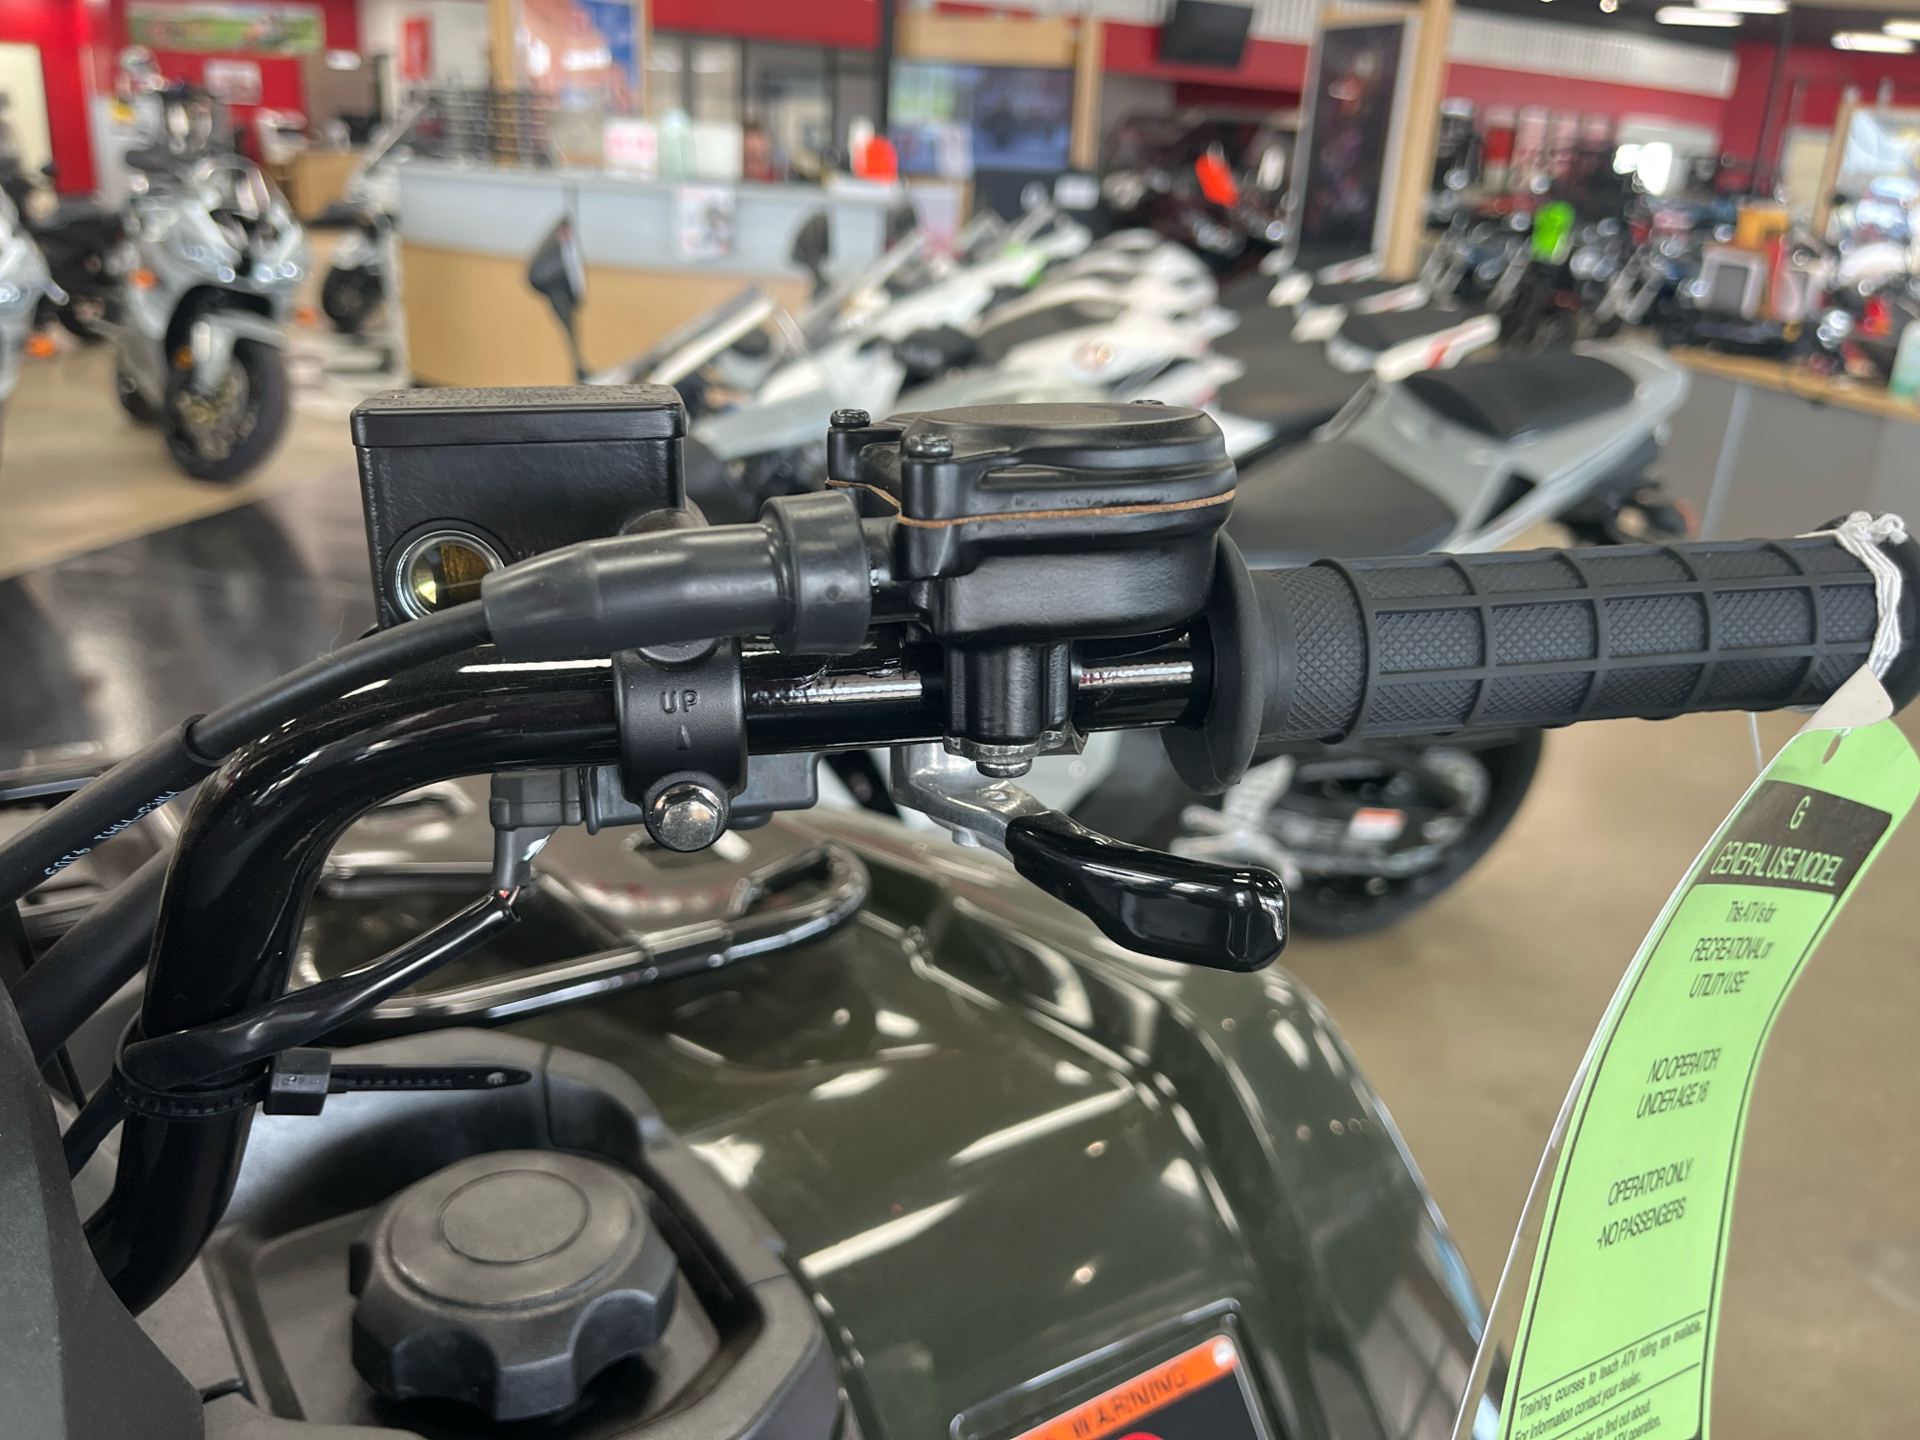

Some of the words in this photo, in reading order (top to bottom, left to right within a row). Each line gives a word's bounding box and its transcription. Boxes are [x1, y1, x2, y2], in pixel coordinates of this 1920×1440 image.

[660, 689, 699, 714] UP
[1789, 795, 1811, 830] G
[1710, 840, 1769, 876] GENERAL
[1766, 845, 1800, 880] USE
[1793, 849, 1843, 886] MODEL
[1725, 900, 1744, 923] This
[1740, 901, 1761, 923] ATV
[1689, 936, 1765, 962] RECREATIONAL
[1689, 972, 1731, 998] UTILITY
[1724, 970, 1750, 995] USE
[1646, 1057, 1669, 1084] NO
[1665, 1047, 1722, 1080] OPERATOR
[1636, 1087, 1678, 1119] UNDER
[1673, 1082, 1700, 1109] AGE
[1696, 1080, 1711, 1104] 16
[1607, 1166, 1667, 1206] OPERATOR
[1664, 1157, 1694, 1187] ONLY
[1617, 1196, 1687, 1243] PASSENGERS
[1520, 1393, 1552, 1420] Training
[1554, 1376, 1586, 1403] courses
[1588, 1370, 1597, 1386] to
[1599, 1357, 1620, 1381] teach
[1621, 1347, 1638, 1369] ATV
[1639, 1340, 1658, 1360] riding
[1660, 1334, 1671, 1350] are
[1071, 1363, 1188, 1439] WARNING
[1530, 1407, 1574, 1440] information
[1574, 1390, 1602, 1416] contact
[1601, 1383, 1618, 1407] your
[1618, 1371, 1641, 1394] dealer.
[1596, 1426, 1604, 1440] to
[1605, 1415, 1619, 1436] find
[1619, 1409, 1631, 1428] out
[1630, 1398, 1650, 1421] about
